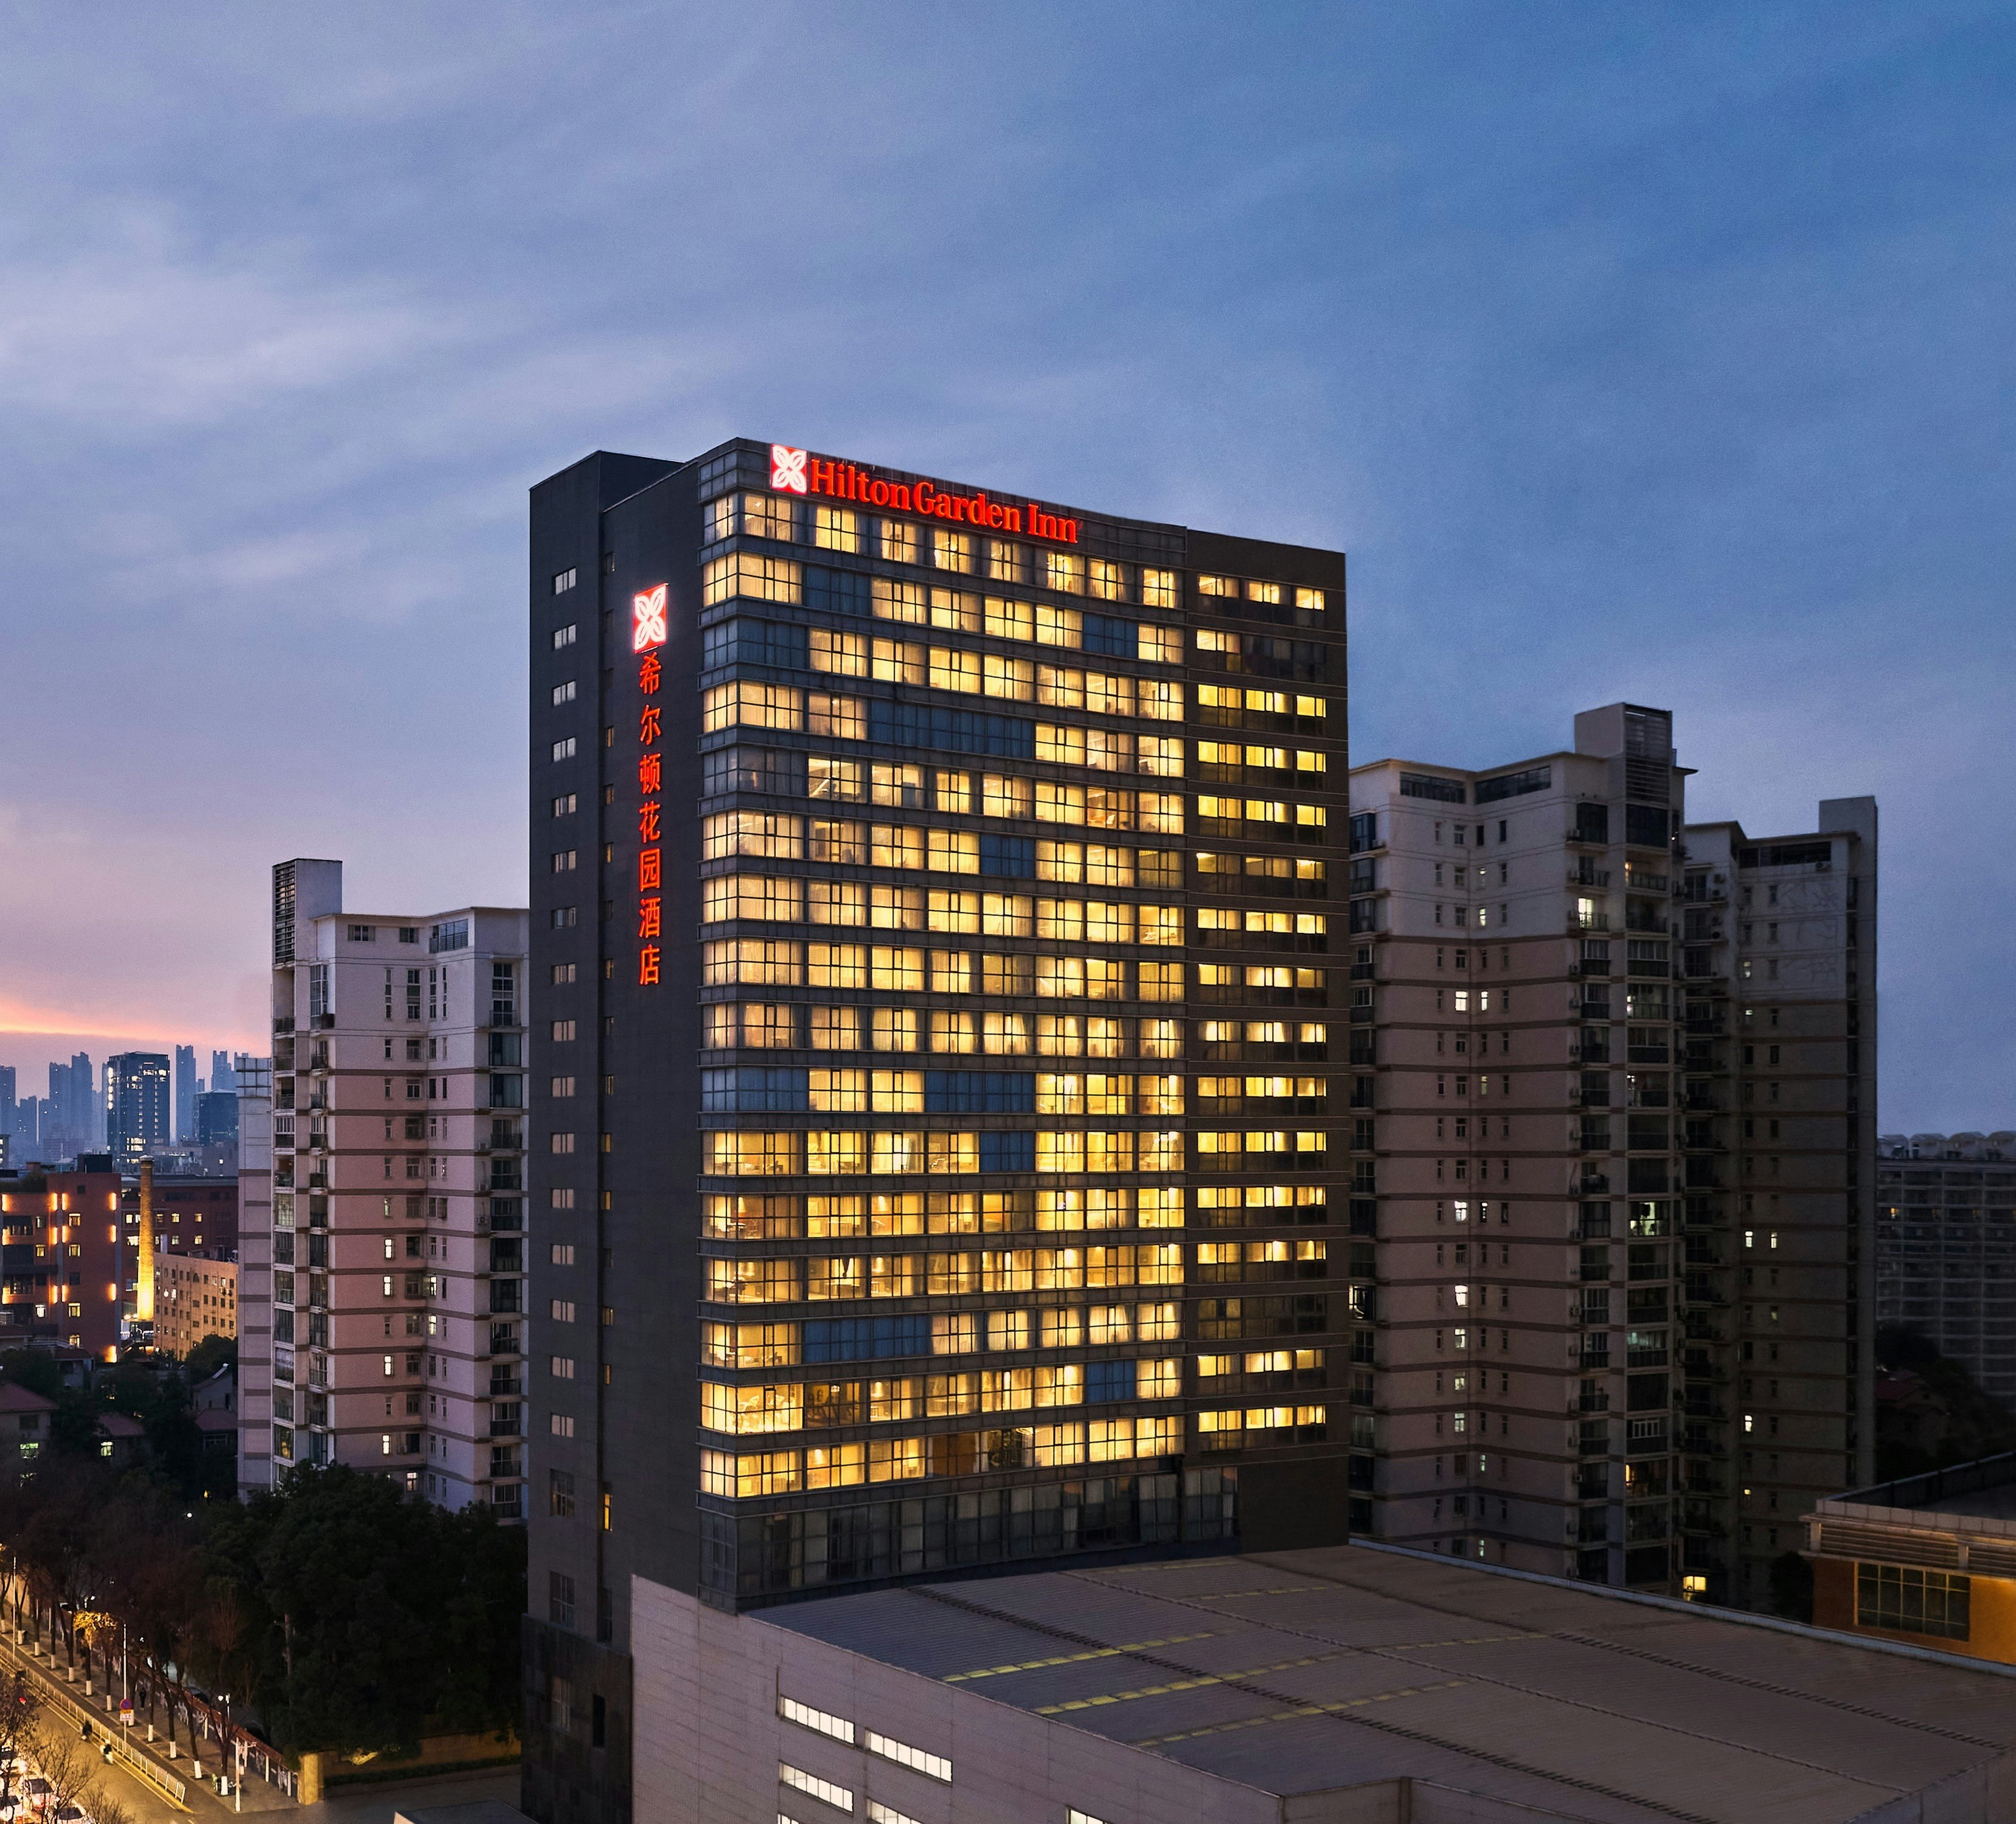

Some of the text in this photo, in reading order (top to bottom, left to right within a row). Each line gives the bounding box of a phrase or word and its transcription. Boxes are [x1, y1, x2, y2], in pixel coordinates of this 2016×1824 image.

[810, 458, 1078, 544] Hilton Garden Inn
[639, 651, 661, 985] 希尔顿花园酒店
